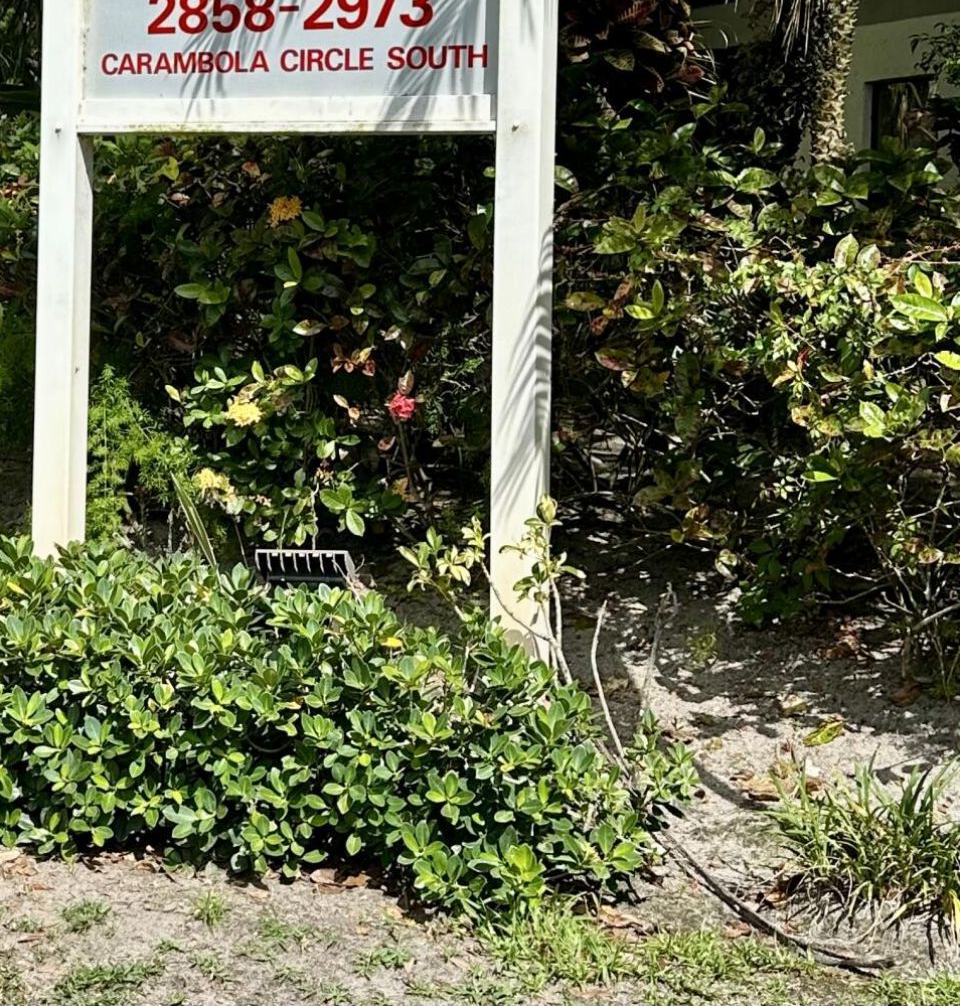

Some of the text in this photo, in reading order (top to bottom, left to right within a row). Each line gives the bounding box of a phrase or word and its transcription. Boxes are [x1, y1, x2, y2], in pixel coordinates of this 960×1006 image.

[101, 45, 488, 75] CARAMBOLA CIRCLE SOUTH
